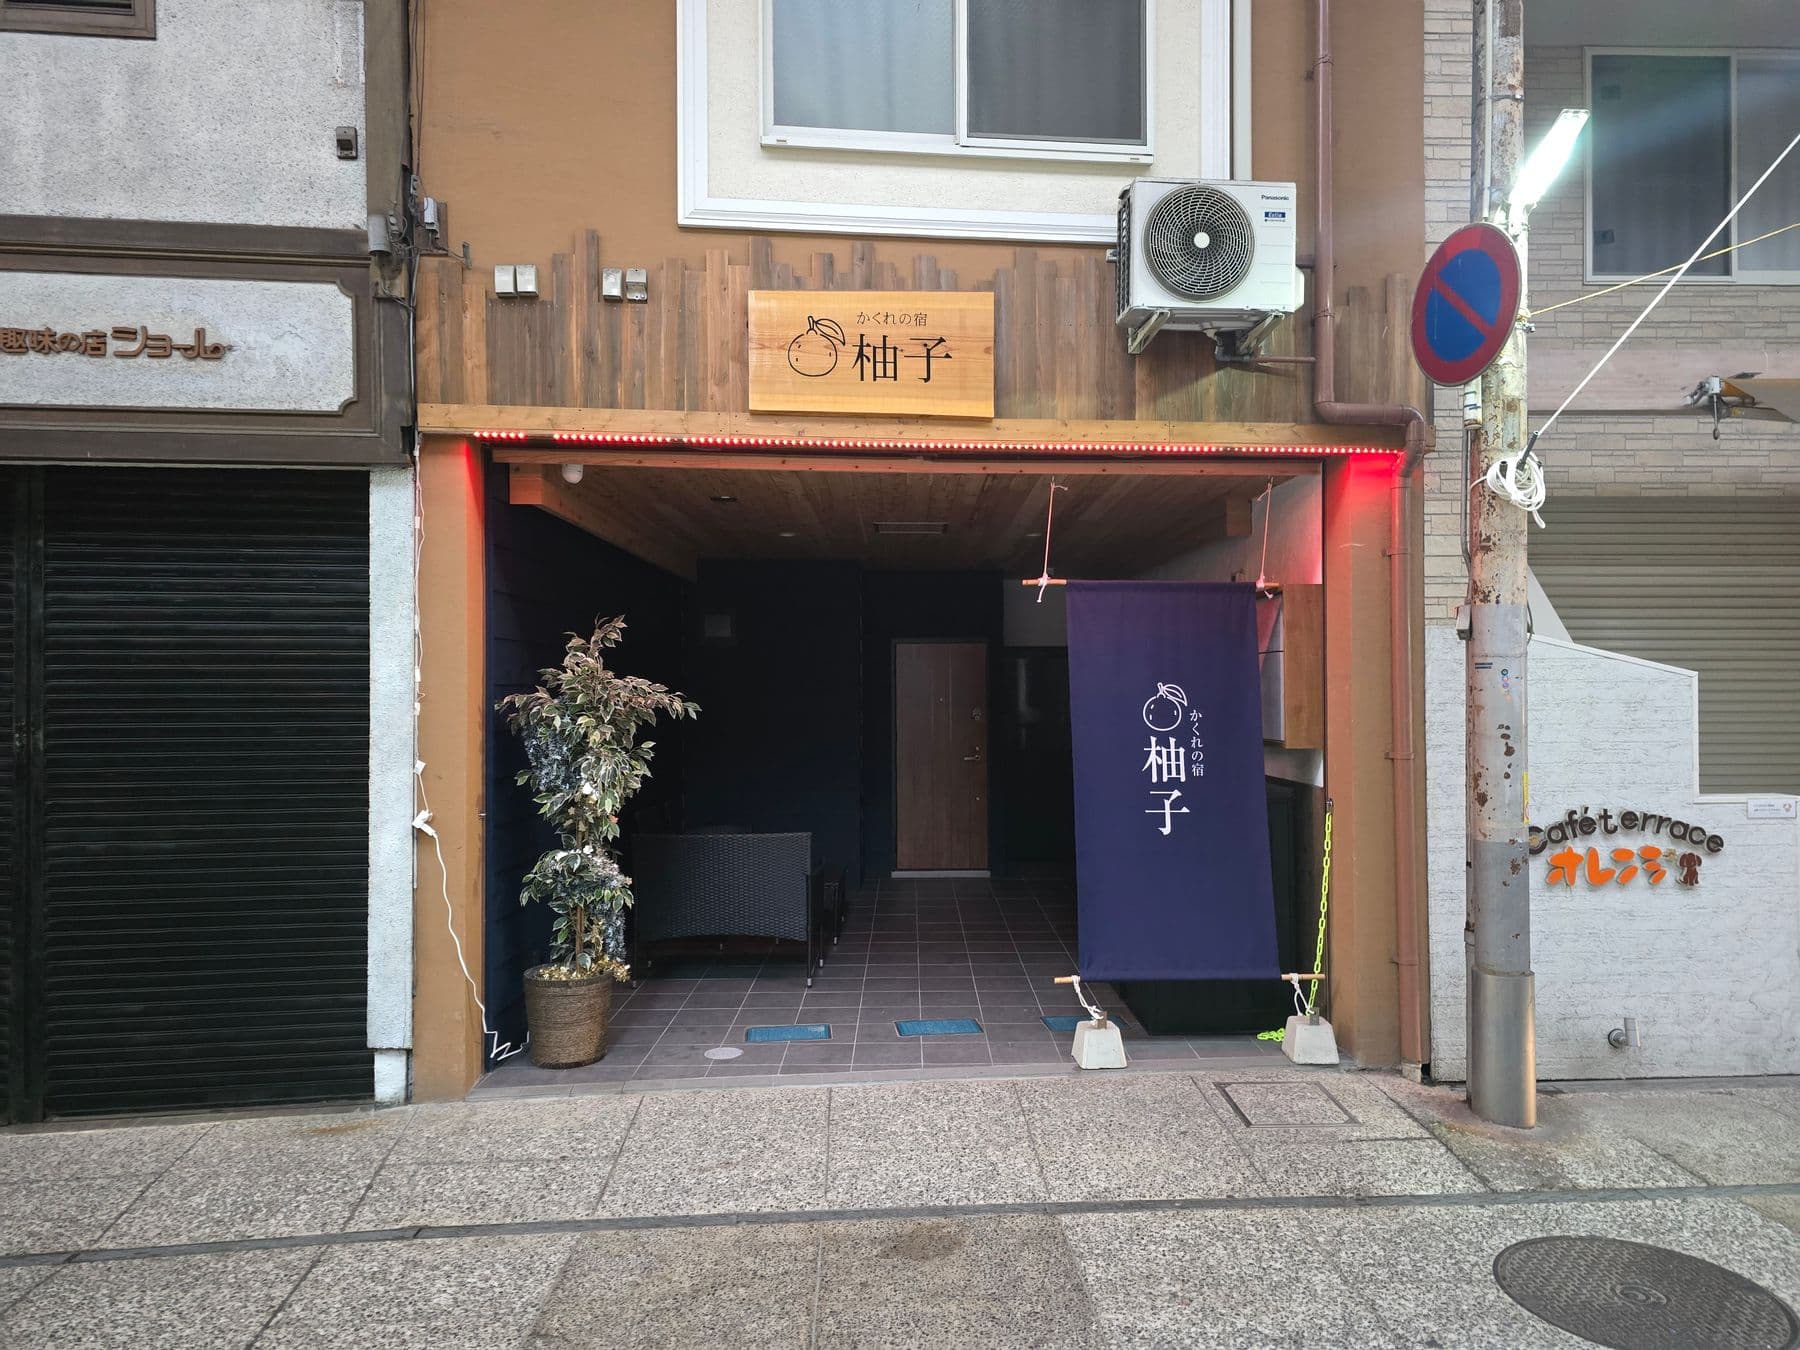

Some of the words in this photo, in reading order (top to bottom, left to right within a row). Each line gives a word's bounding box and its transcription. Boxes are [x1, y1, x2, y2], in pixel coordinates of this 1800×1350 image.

[856, 311, 928, 327] かくれの宿
[851, 333, 953, 383] 柚子
[1189, 709, 1205, 777] かくれの宿
[1142, 735, 1190, 836] 柚子
[1599, 807, 1725, 854] terrace
[1546, 845, 1678, 888] オレンジ
